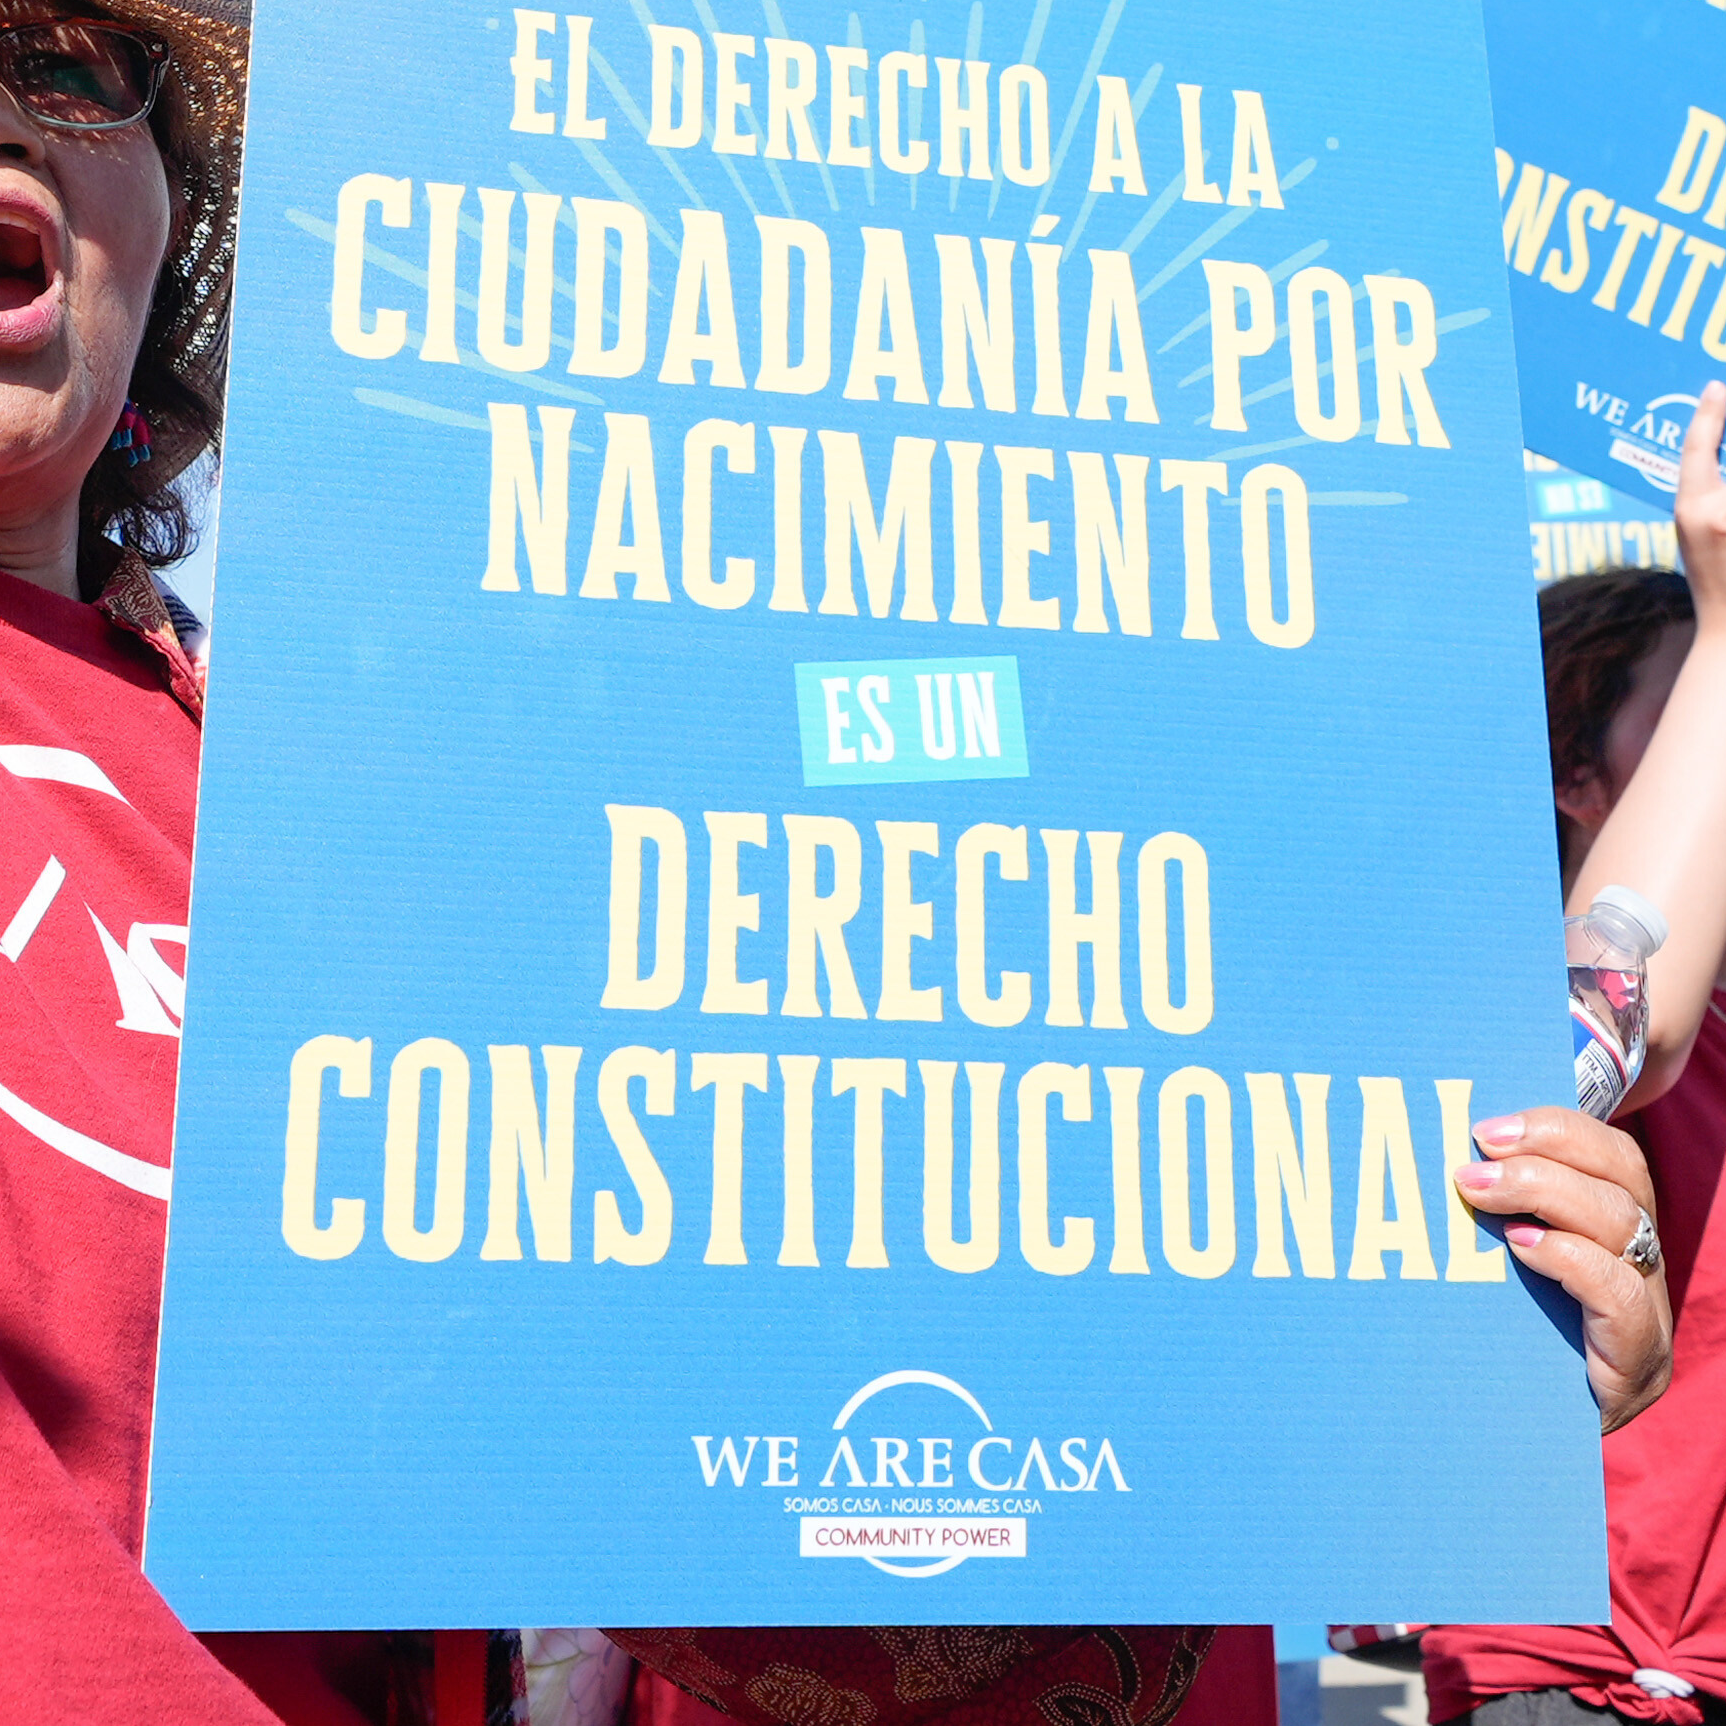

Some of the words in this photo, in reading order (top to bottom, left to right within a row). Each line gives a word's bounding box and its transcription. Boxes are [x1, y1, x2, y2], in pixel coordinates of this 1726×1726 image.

[509, 9, 606, 138] EL
[646, 26, 1052, 188] DERECHO
[1089, 75, 1148, 195] A
[1176, 83, 1286, 210] LA
[330, 172, 1162, 424] CIUDADANÍA
[1209, 260, 1451, 450] POR
[1576, 381, 1630, 426] WE
[1630, 410, 1685, 452] AR
[480, 402, 1317, 650] NACIMIENTO
[820, 675, 895, 764] ES
[920, 671, 1000, 760] UN
[600, 803, 1215, 1035] DERECHO
[281, 1035, 1508, 1282] CONSTITUCIONAL
[691, 1436, 799, 1487] WE
[819, 1436, 954, 1488] ARE
[968, 1436, 1132, 1492] CASA
[783, 1497, 839, 1513] SOMOS
[841, 1498, 882, 1513] CASA
[891, 1499, 933, 1513] NOUS
[936, 1498, 1000, 1513] SOMMES
[1002, 1499, 1042, 1514] CASA
[815, 1528, 936, 1547] COMMUNITY
[942, 1528, 1011, 1547] POWER
